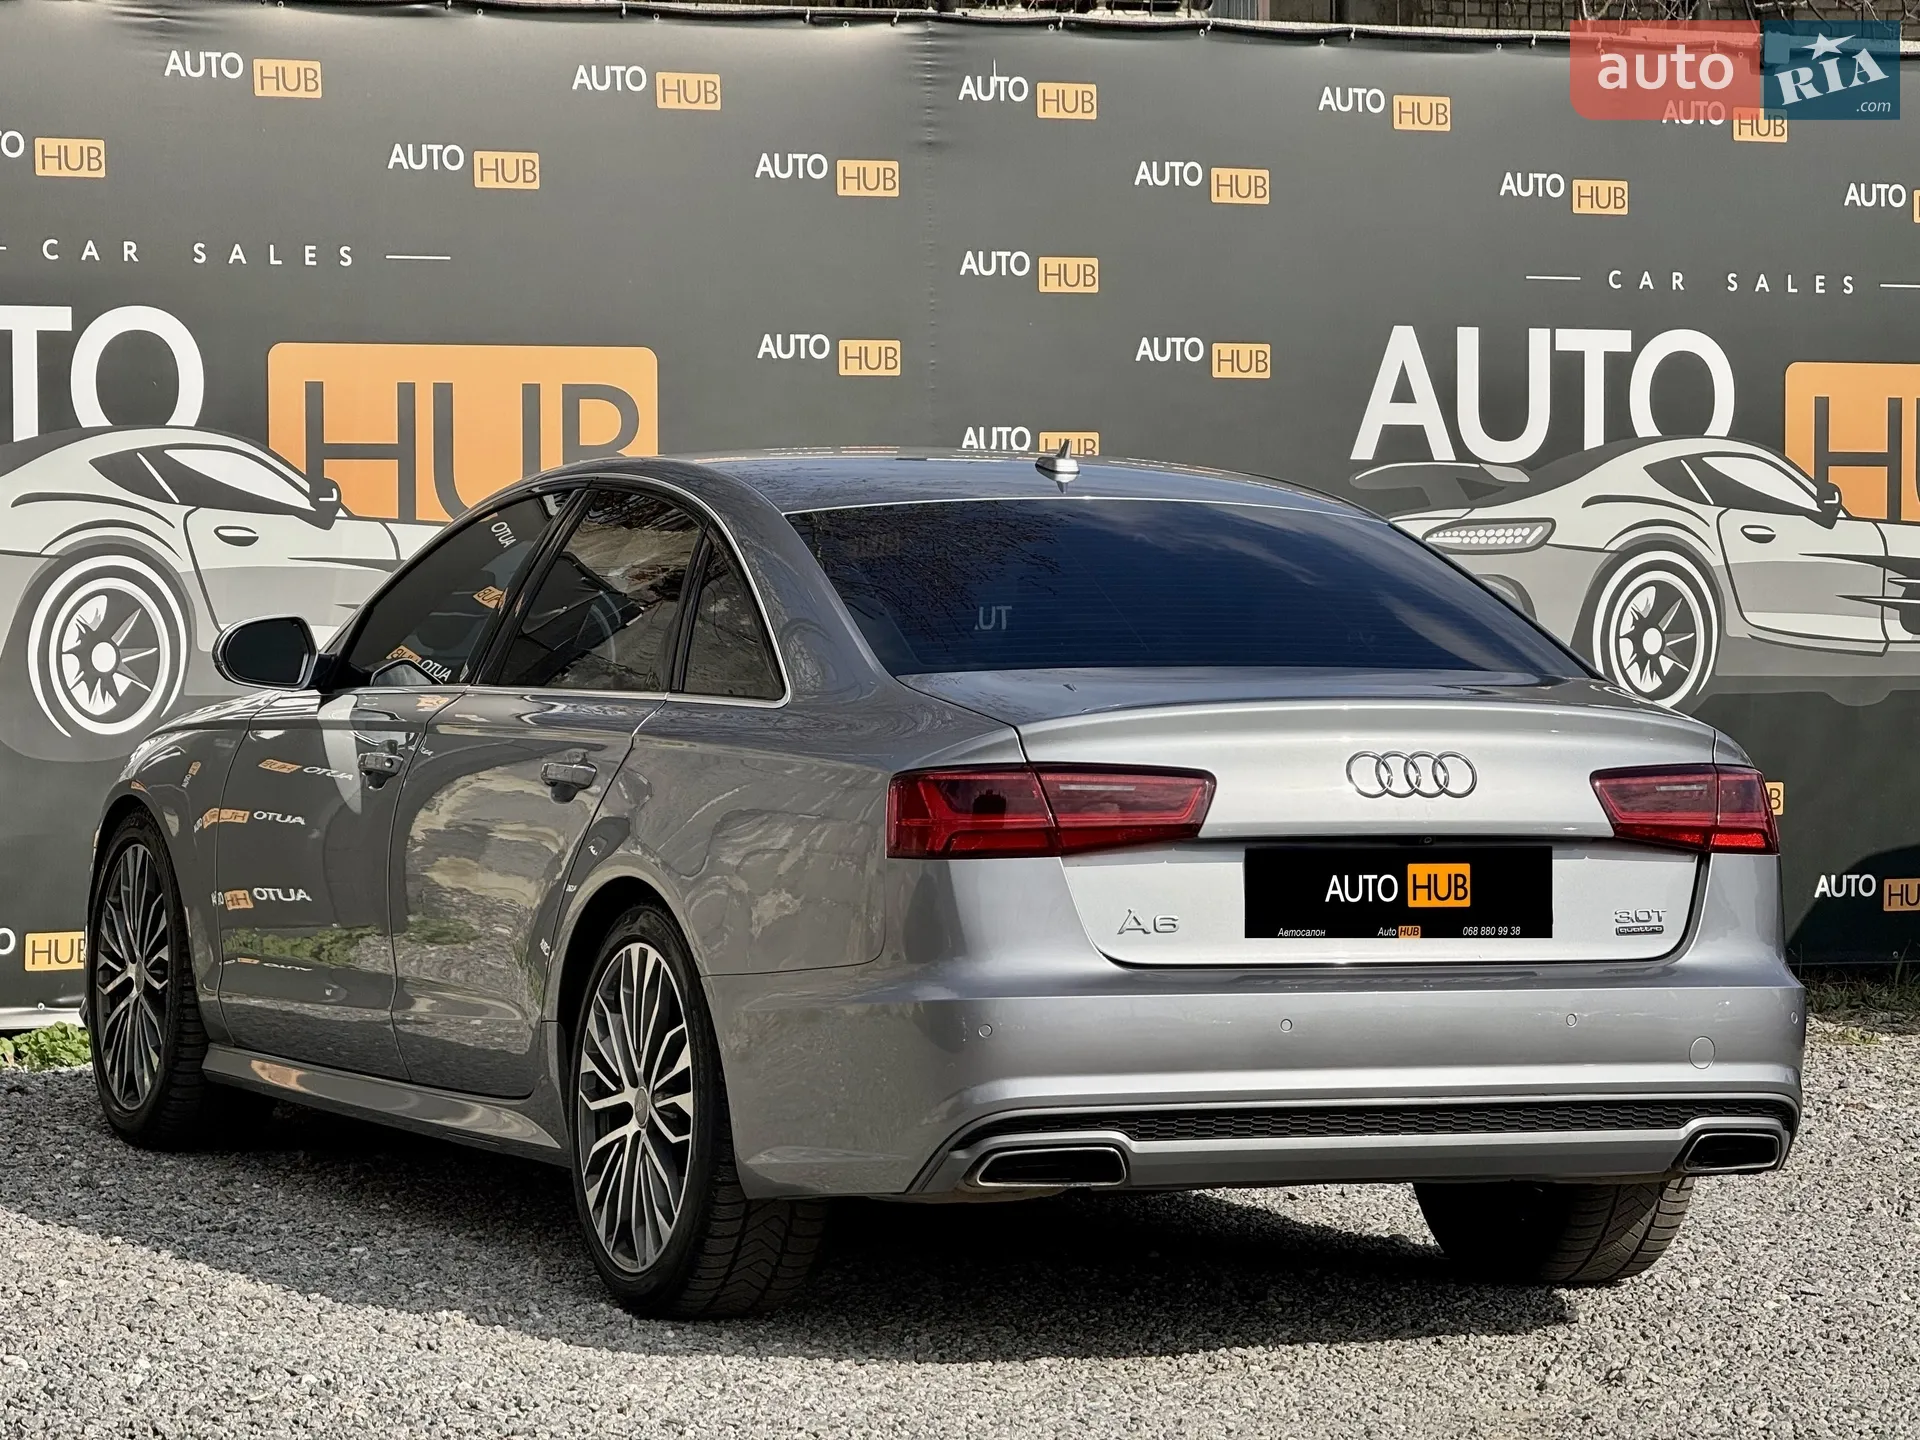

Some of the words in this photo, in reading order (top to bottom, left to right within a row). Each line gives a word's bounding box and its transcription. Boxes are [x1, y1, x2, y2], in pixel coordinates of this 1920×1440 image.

[164, 50, 244, 79] AUTO
[259, 65, 320, 93] HUB
[572, 64, 647, 92] AUTO
[661, 78, 719, 105] HUB
[958, 75, 1029, 102] AUTO
[1041, 88, 1096, 114] HUB
[1318, 86, 1386, 114] AUTO
[1397, 101, 1449, 126] HUB
[1662, 100, 1726, 126] AUTO
[1738, 111, 1786, 138] HUB
[40, 144, 103, 172] HUB
[387, 143, 465, 171] AUTO
[479, 157, 537, 184] HUB
[754, 152, 828, 180] AUTO
[841, 166, 898, 192] HUB
[1134, 160, 1203, 187] AUTO
[1215, 173, 1268, 199] HUB
[1499, 171, 1565, 198] AUTO
[1577, 185, 1626, 210] HUB
[1843, 182, 1907, 208] AUTO
[42, 239, 139, 262] CAR
[193, 242, 352, 267] SALES
[959, 250, 1031, 277] AUTO
[1043, 263, 1097, 288] HUB
[1608, 270, 1685, 291] CAR
[1727, 272, 1854, 295] SALES
[757, 333, 830, 360] AUTO
[843, 346, 899, 371] HUB
[1135, 336, 1204, 362] AUTO
[1216, 349, 1269, 374] HUB
[1350, 325, 1735, 463] AUTO
[961, 426, 1031, 451] AUTO
[1814, 874, 1877, 898] AUTO
[1117, 908, 1180, 935] A6
[1614, 908, 1667, 924] 3.0T
[1618, 925, 1663, 935] quattro
